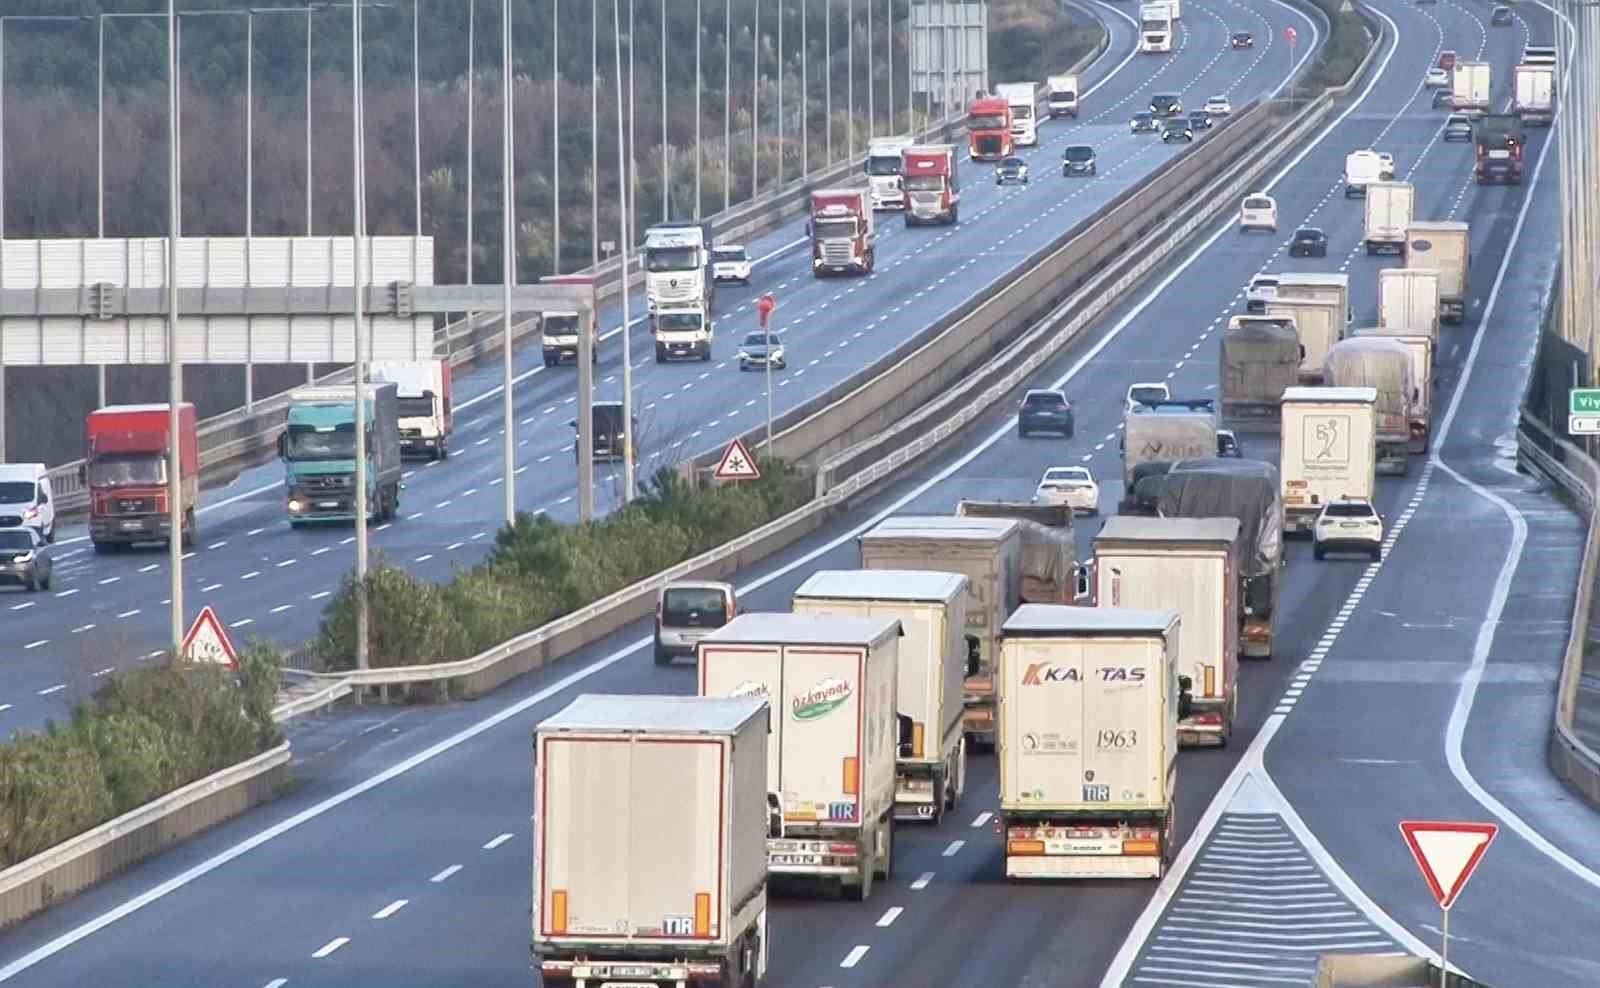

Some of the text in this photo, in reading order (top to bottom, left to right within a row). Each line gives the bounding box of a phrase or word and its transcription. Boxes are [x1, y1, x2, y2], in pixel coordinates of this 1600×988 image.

[1044, 666, 1147, 681] KATAS
[1096, 729, 1137, 748] 1963
[1085, 786, 1109, 801] TIR
[830, 801, 855, 818] TIR
[664, 918, 693, 935] TIR
